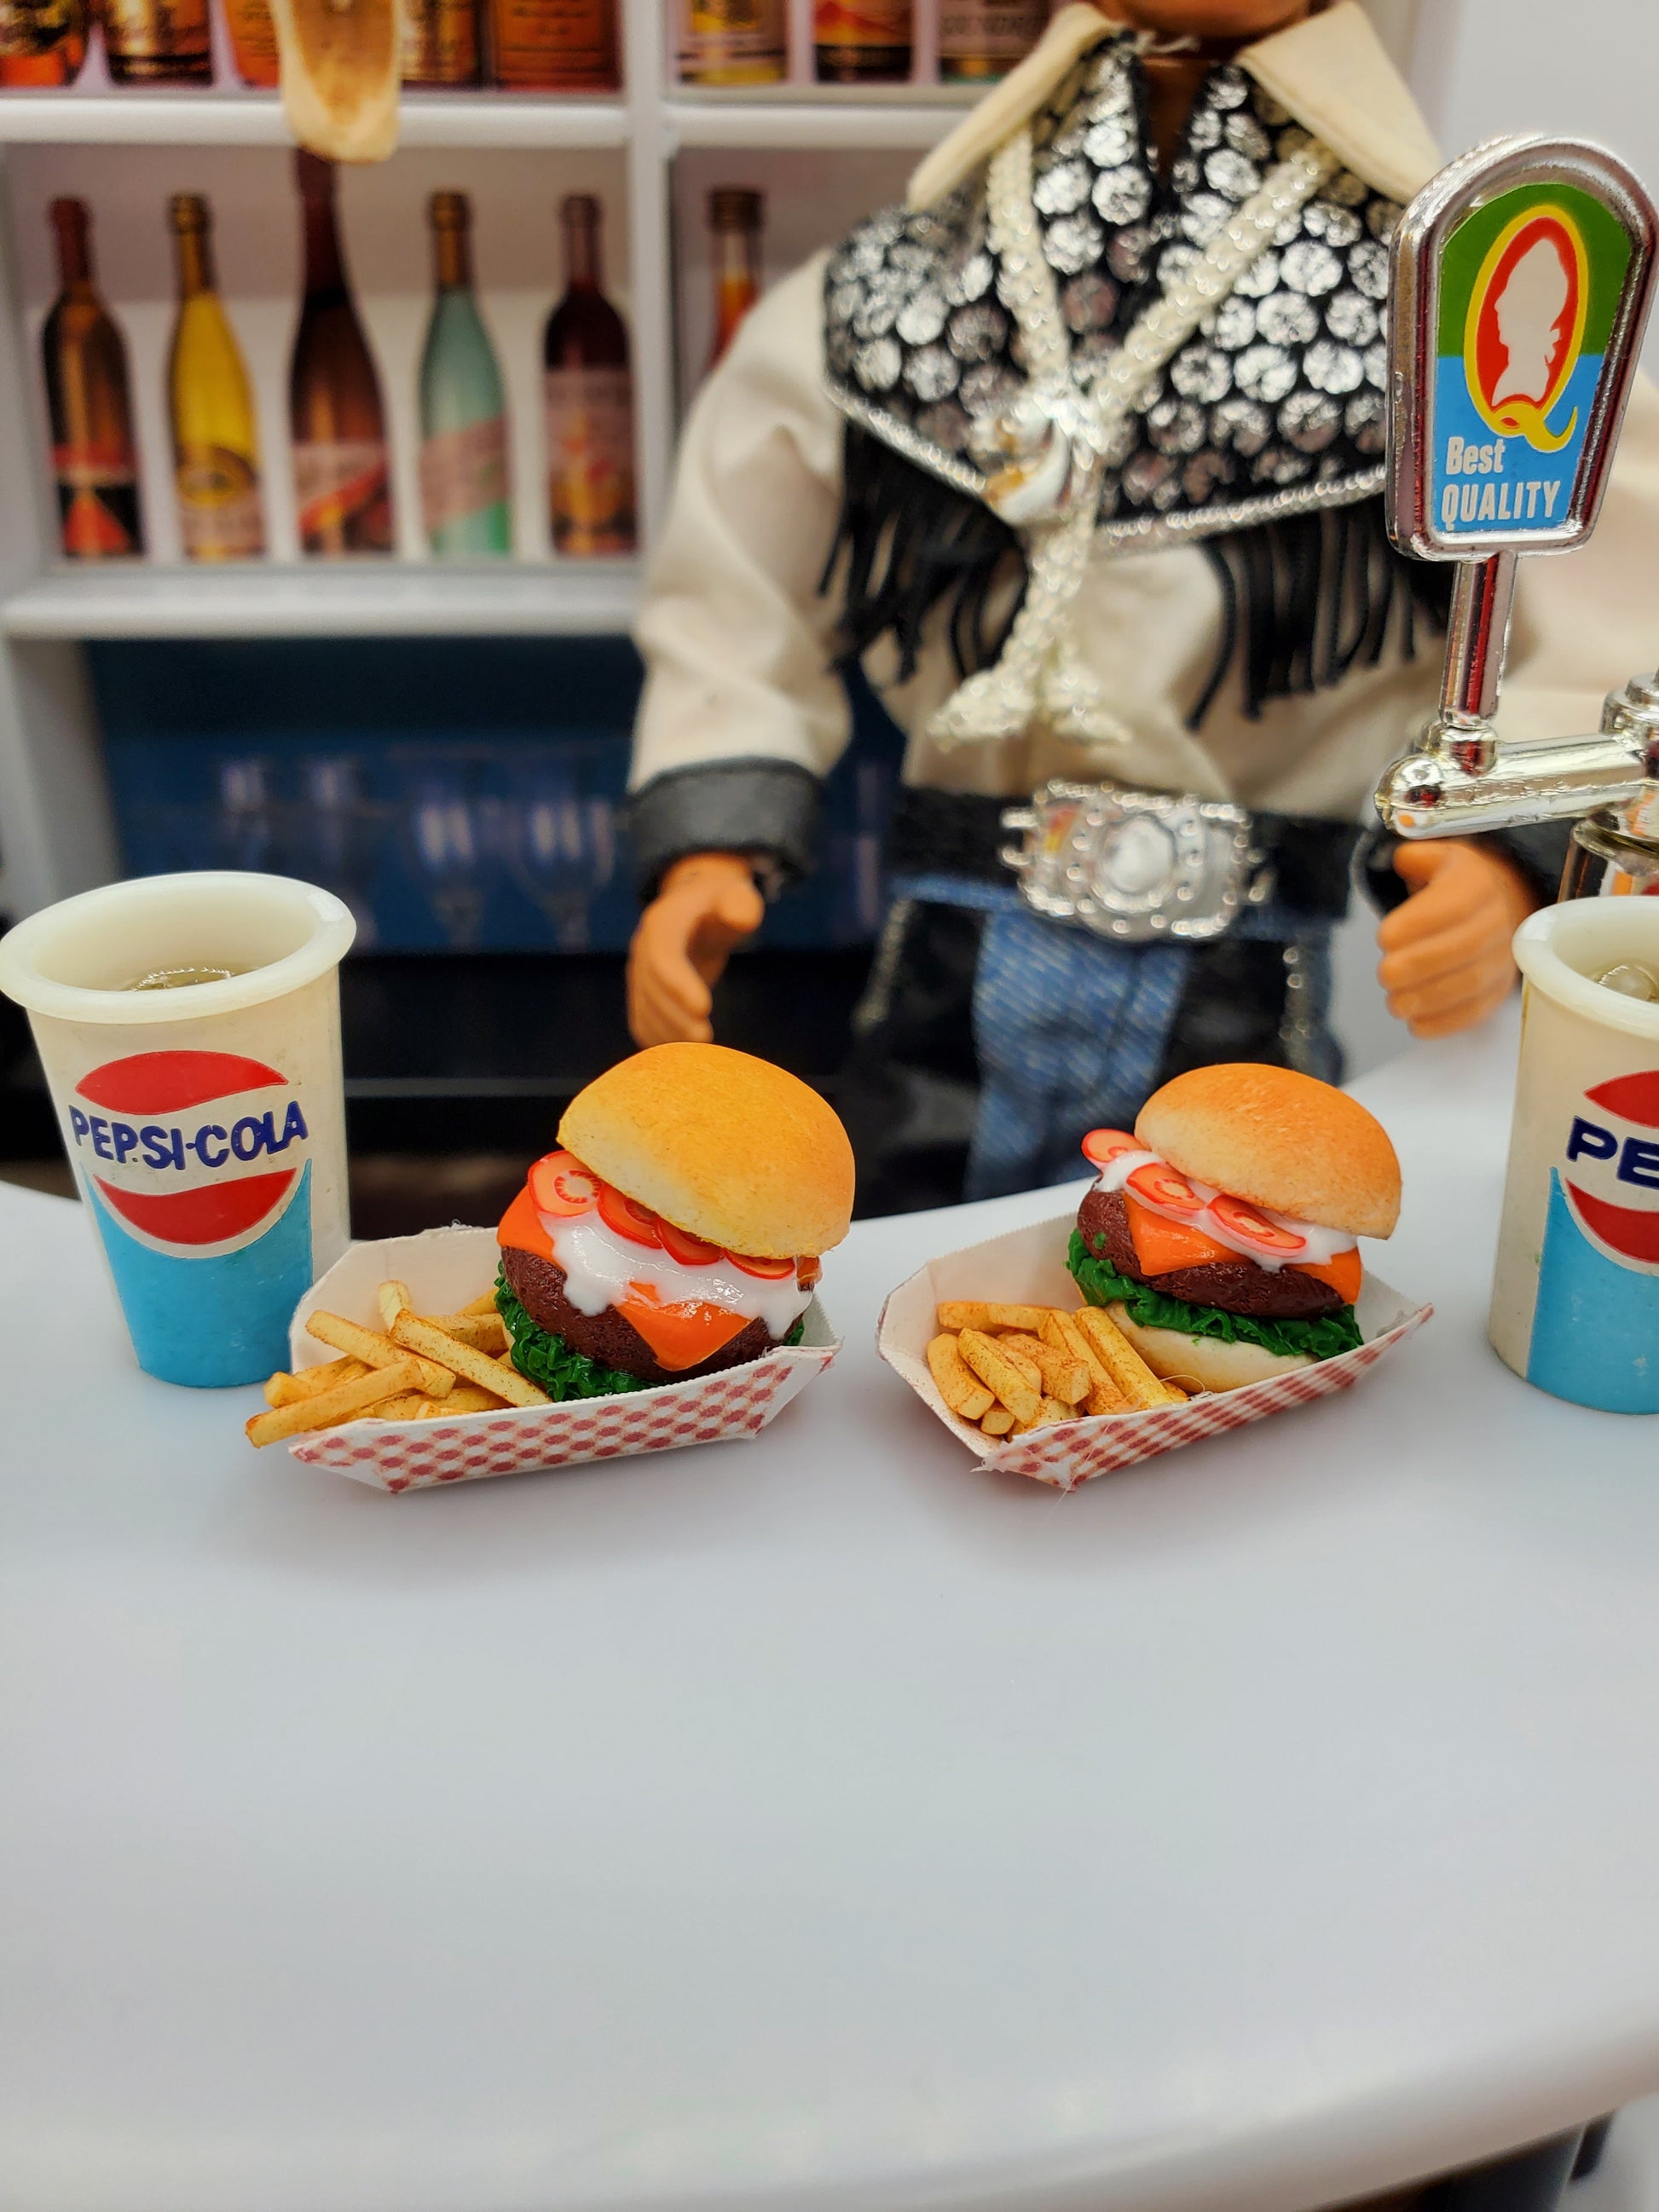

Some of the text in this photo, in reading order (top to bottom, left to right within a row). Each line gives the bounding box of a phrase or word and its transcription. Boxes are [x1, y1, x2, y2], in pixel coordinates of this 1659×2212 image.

[1447, 436, 1505, 475] Best
[1442, 481, 1561, 531] QUALITY
[68, 1100, 308, 1170] PEPSI-COLA
